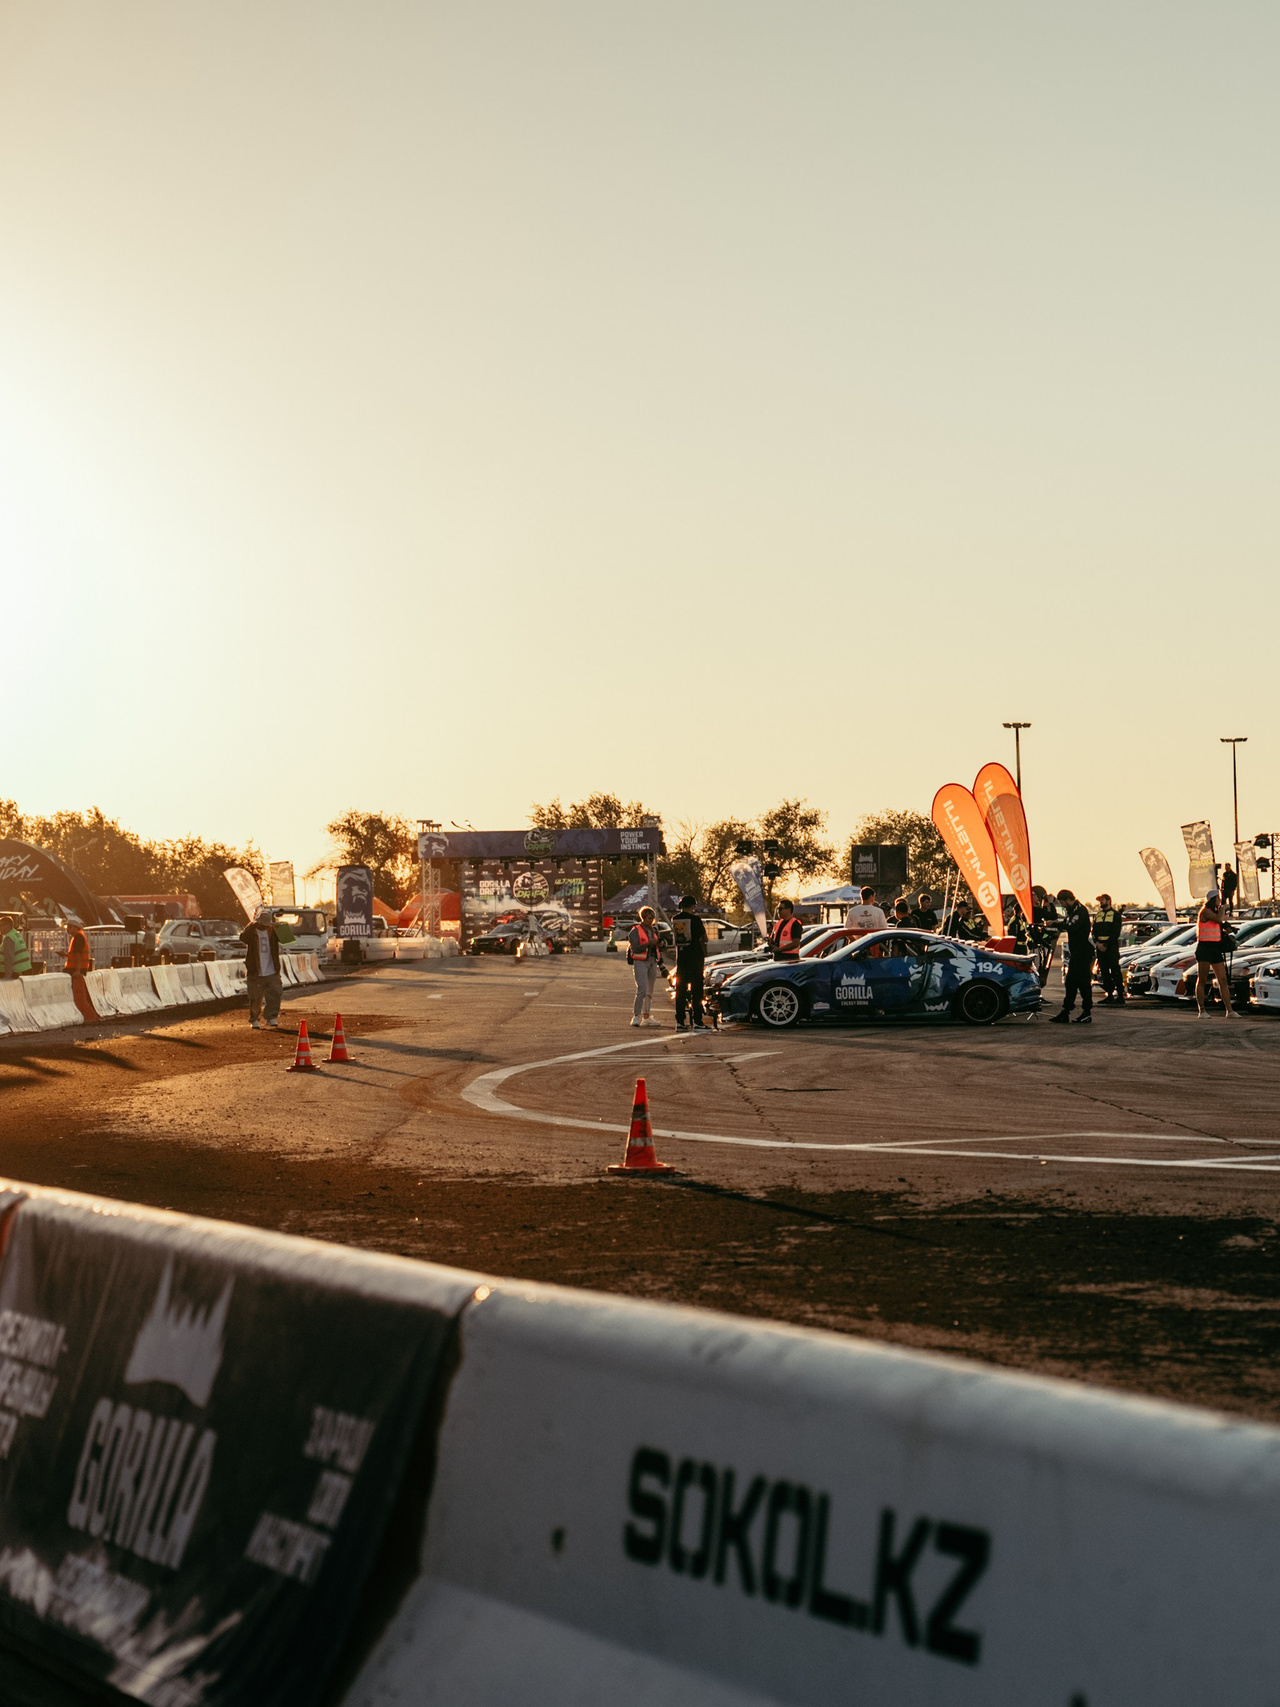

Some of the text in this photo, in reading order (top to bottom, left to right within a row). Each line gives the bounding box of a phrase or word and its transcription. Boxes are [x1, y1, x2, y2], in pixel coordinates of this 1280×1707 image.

[854, 863, 882, 873] GORILLA
[479, 880, 511, 888] GORILLA
[340, 924, 371, 936] GORILLA
[976, 961, 1003, 975] 194
[835, 986, 873, 999] GORILLA
[67, 1397, 217, 1571] GORILLA
